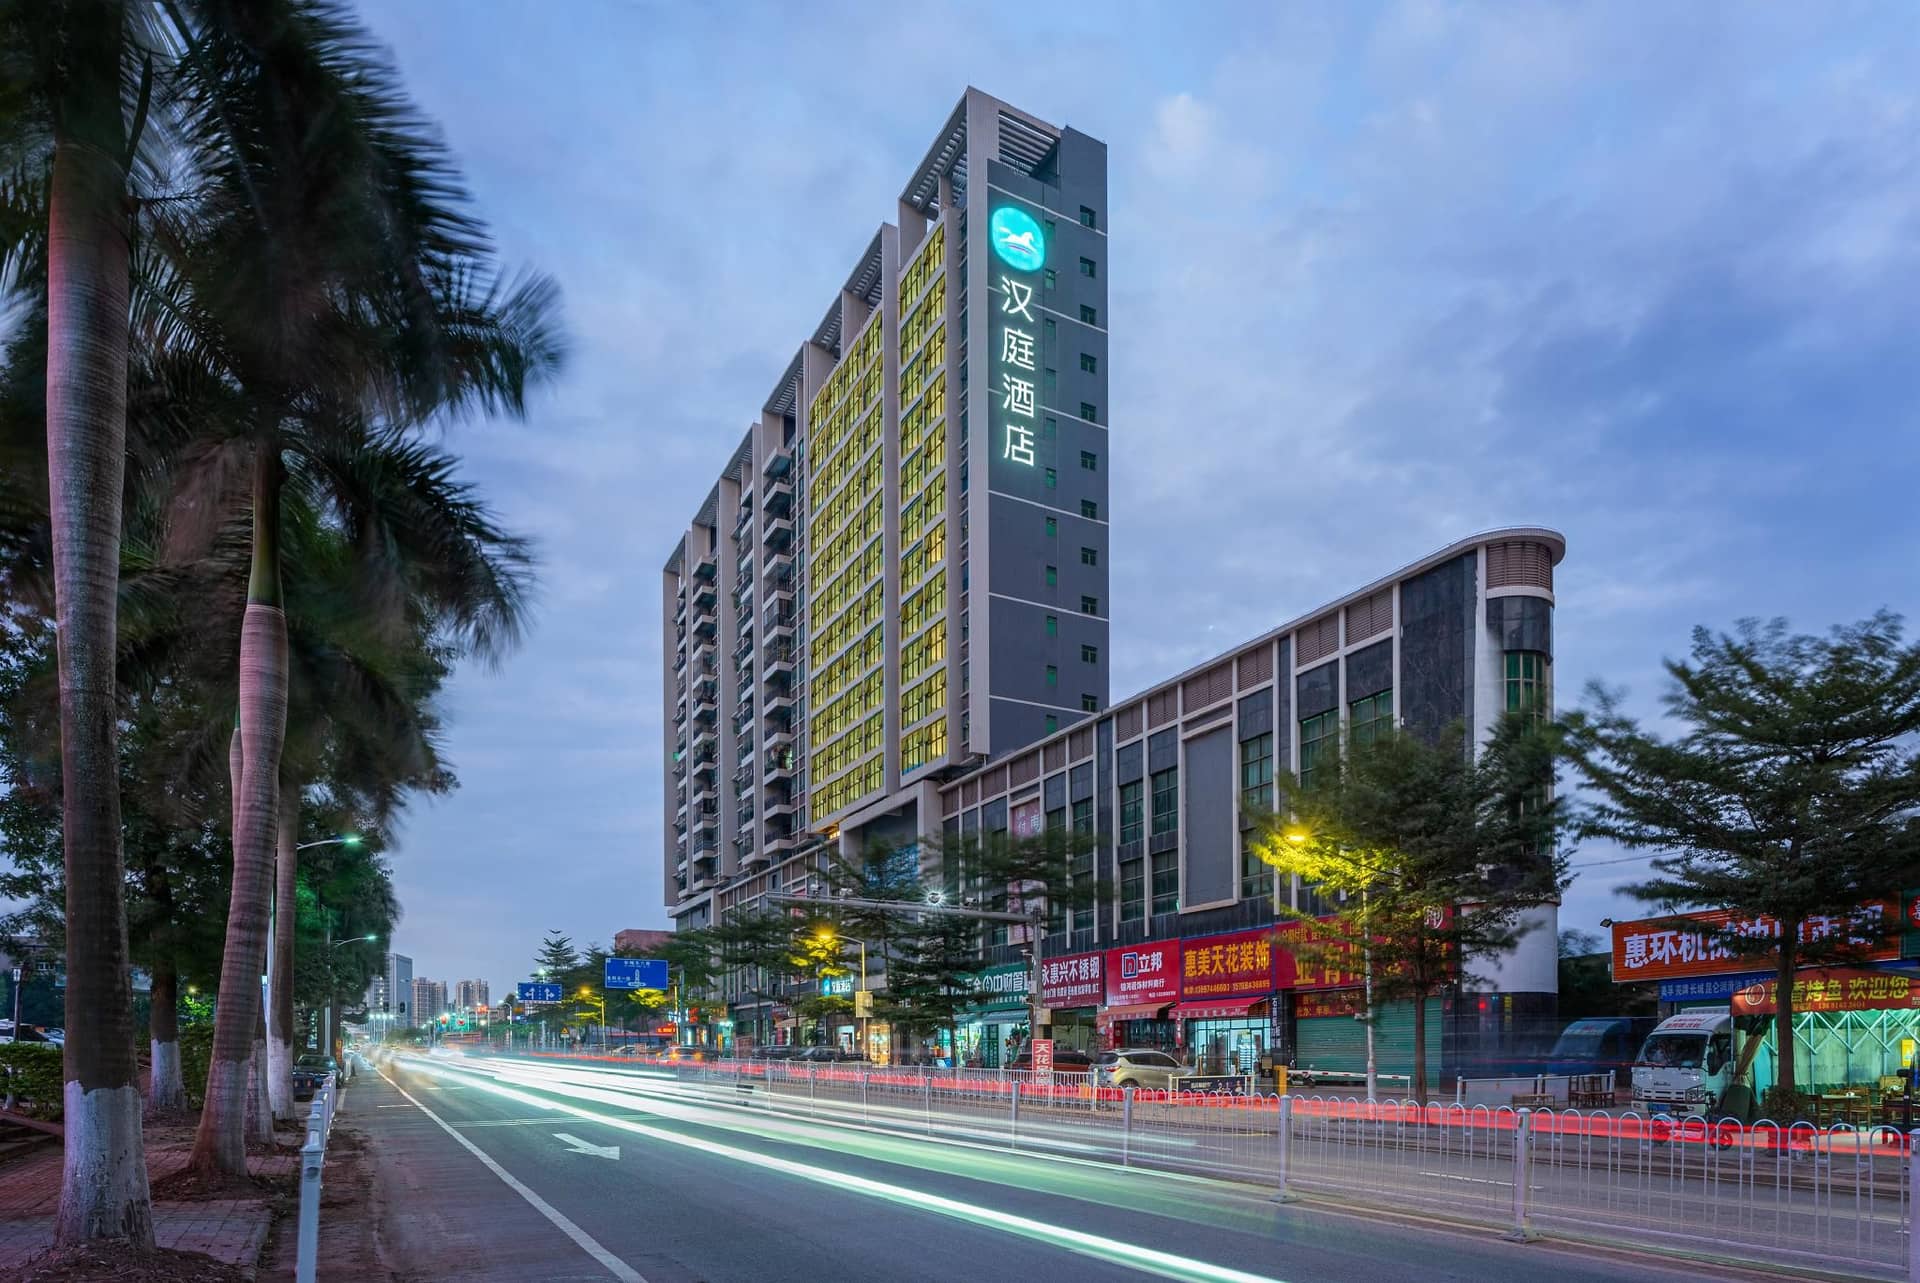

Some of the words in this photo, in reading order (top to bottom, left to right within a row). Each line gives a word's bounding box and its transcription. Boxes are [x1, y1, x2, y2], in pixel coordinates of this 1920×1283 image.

[1001, 275, 1035, 467] 汉庭酒店
[1041, 955, 1100, 987] 永惠兴不锈钢
[1138, 951, 1163, 974] 立邦
[1184, 939, 1271, 977] 惠美天花装饰
[1848, 975, 1909, 1000] 欢迎您
